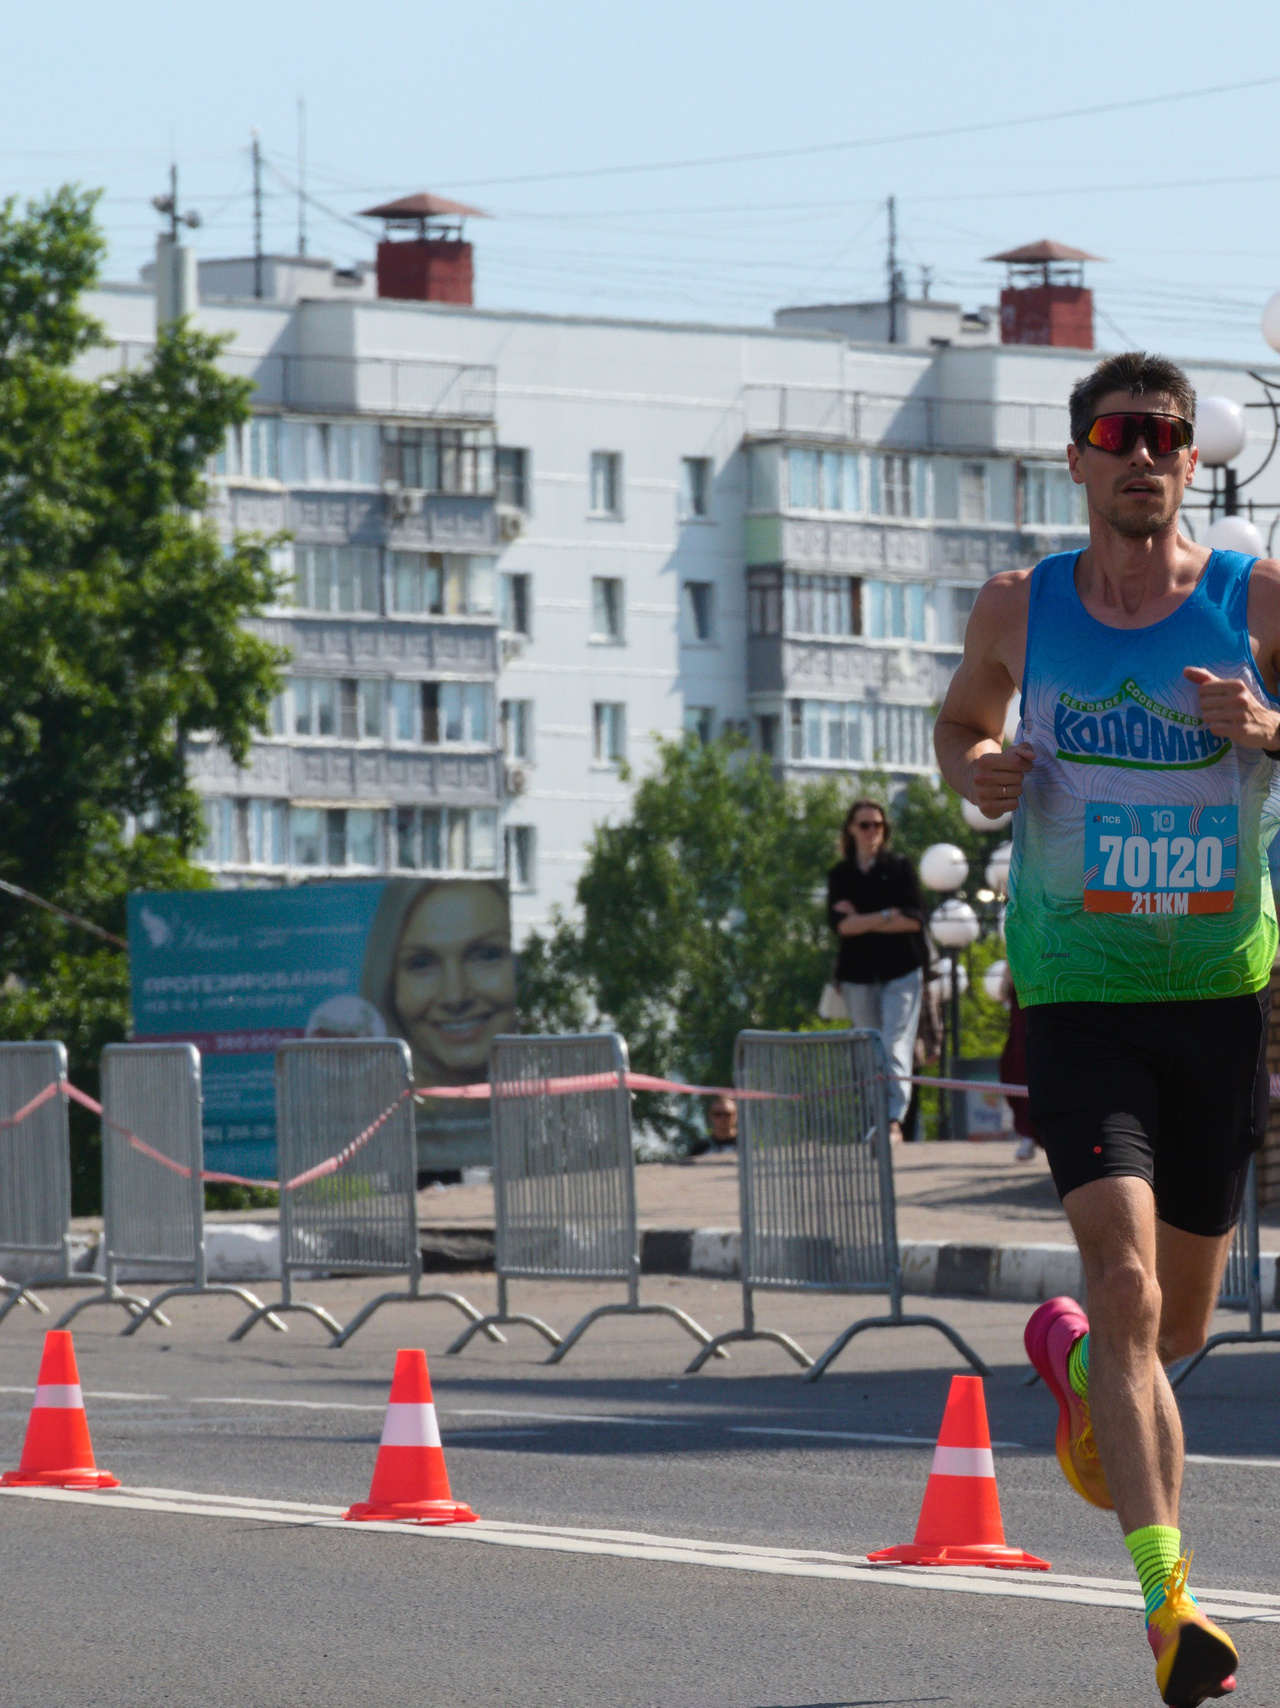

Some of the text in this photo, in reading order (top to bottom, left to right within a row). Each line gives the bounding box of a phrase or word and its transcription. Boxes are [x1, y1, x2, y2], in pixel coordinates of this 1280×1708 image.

[1062, 681, 1200, 725] БЕГОВОЕ СООБЩЕСТВО
[1102, 815, 1121, 824] ПСБ
[1151, 810, 1175, 832] 10
[1099, 835, 1223, 888] 70120
